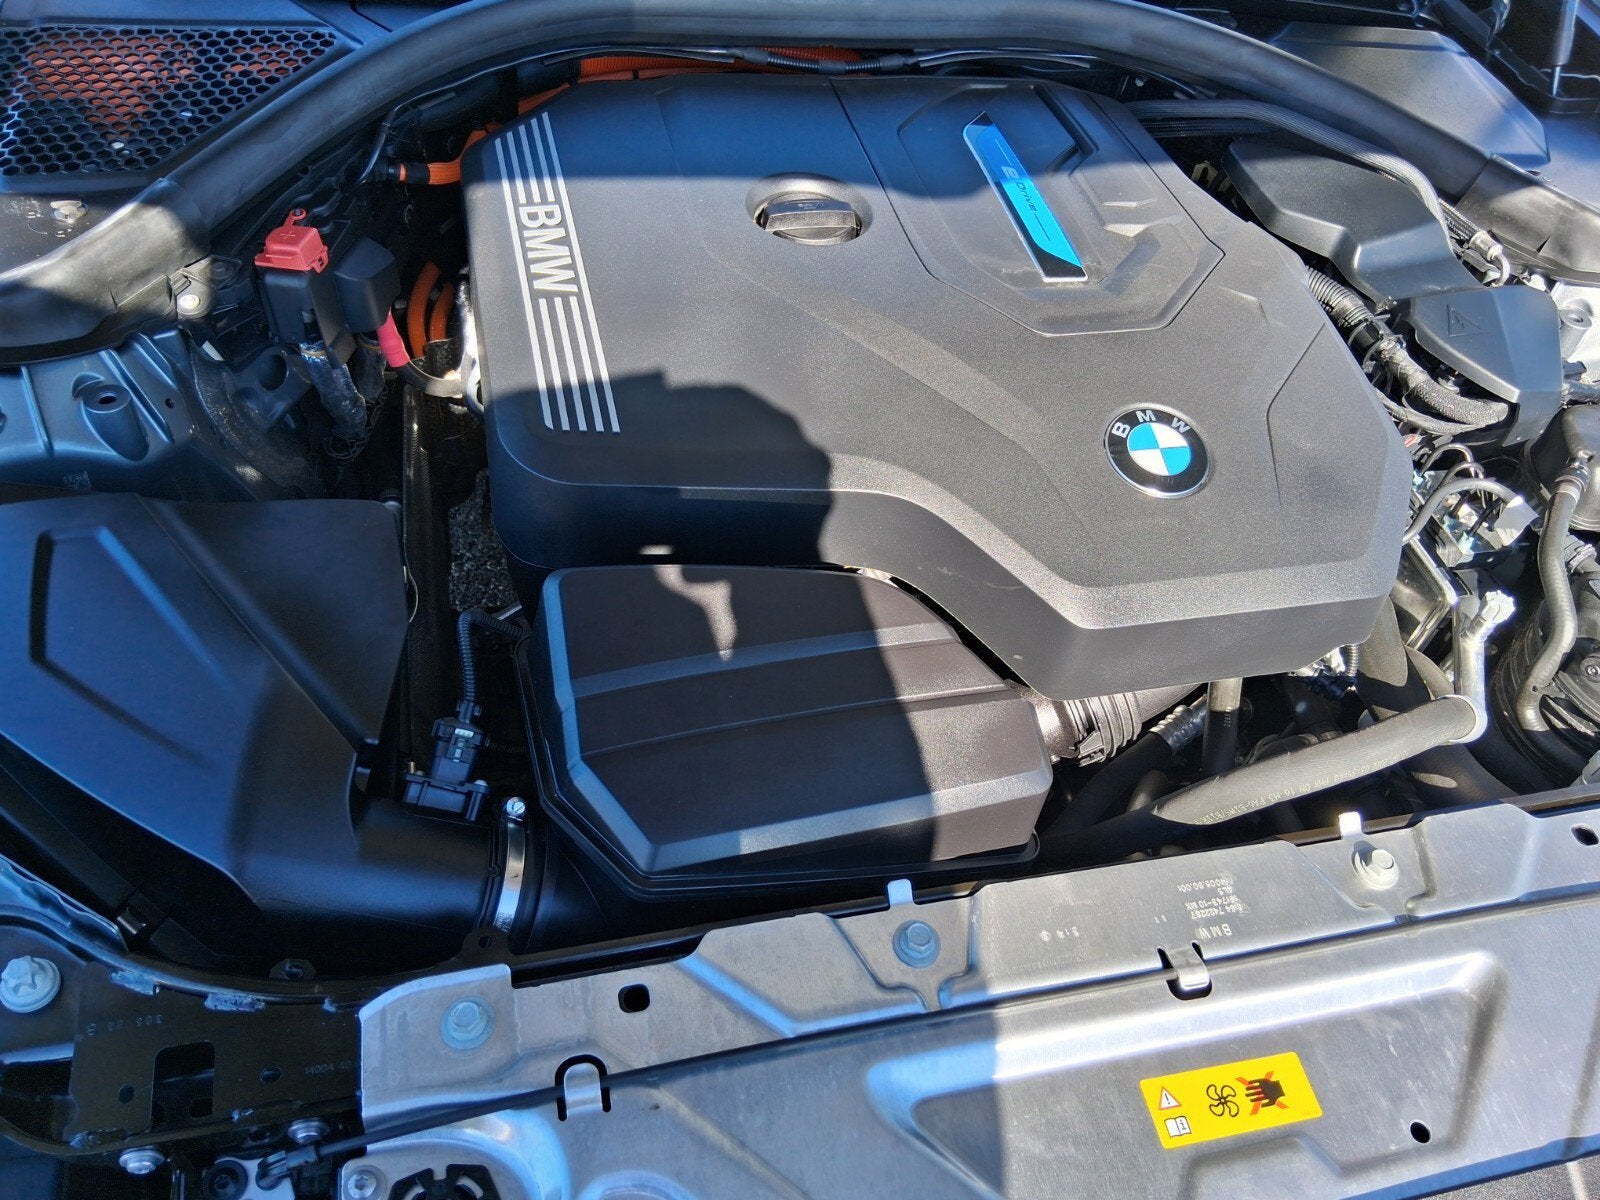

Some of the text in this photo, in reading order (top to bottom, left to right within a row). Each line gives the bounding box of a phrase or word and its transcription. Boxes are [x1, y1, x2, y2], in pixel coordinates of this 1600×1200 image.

[519, 204, 579, 292] BMW
[1111, 409, 1191, 438] BMW
[1198, 923, 1232, 941] BMW
